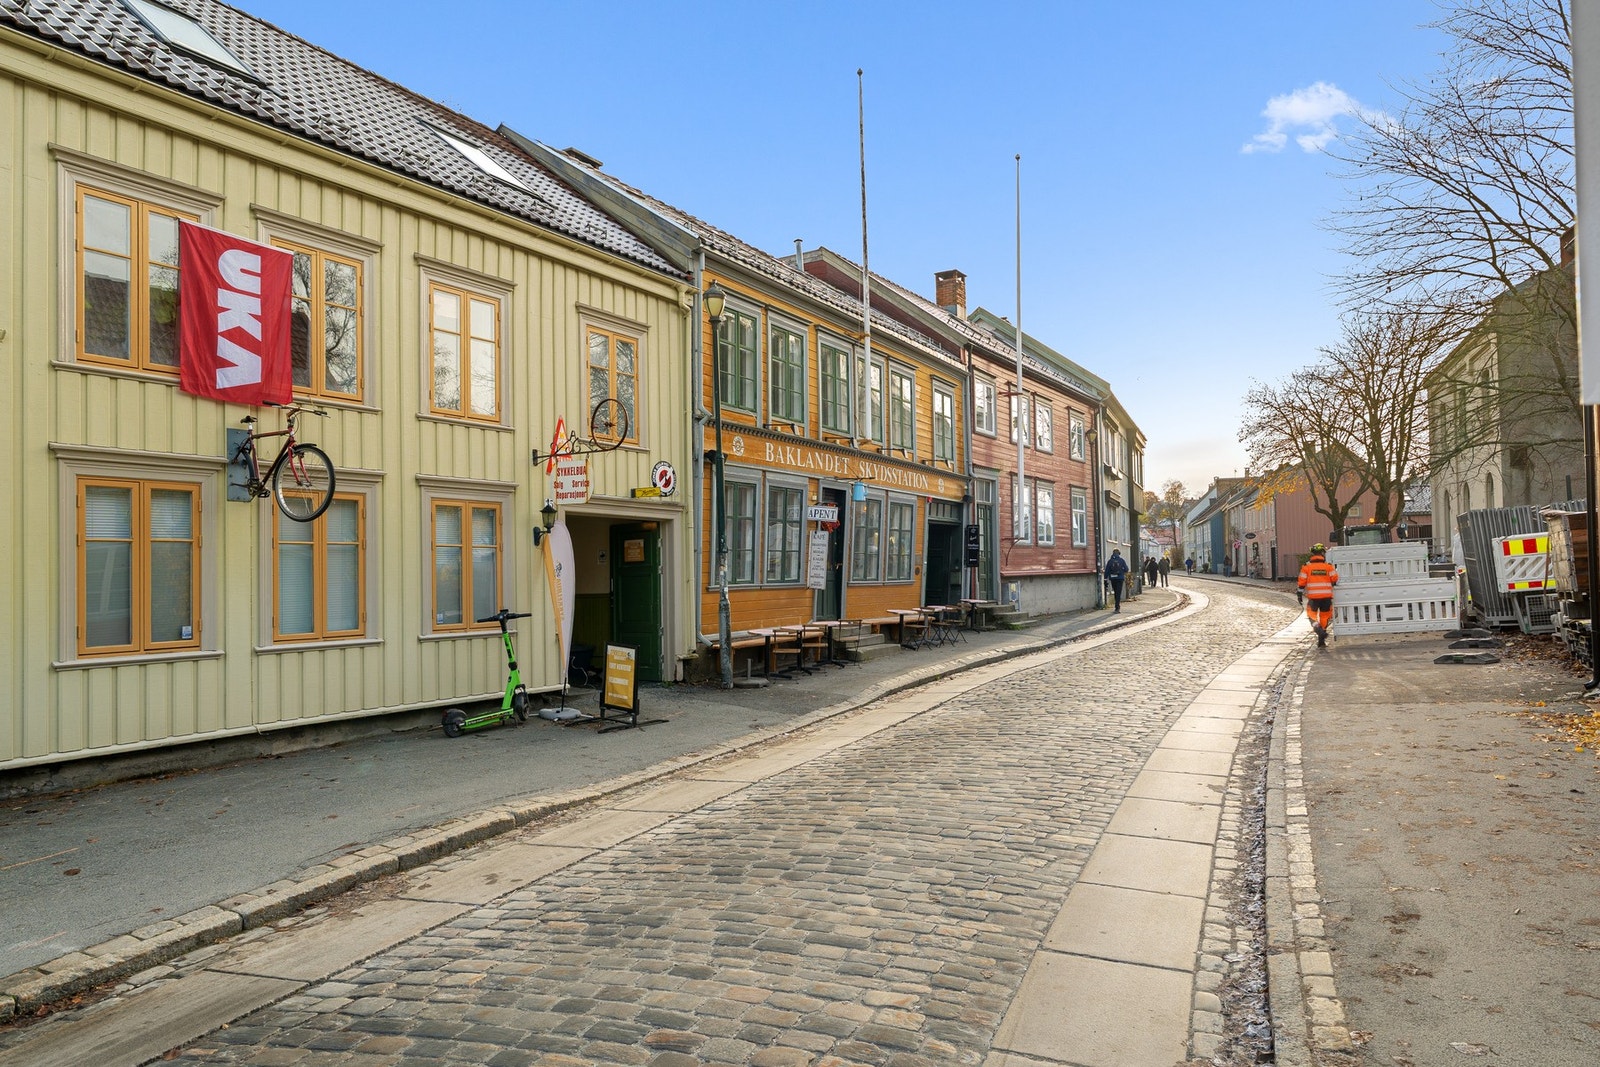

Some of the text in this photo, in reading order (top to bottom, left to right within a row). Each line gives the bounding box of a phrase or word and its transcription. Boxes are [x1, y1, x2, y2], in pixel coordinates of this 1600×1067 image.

[216, 249, 262, 390] UKA
[556, 465, 587, 477] SYKKELBUA
[765, 442, 850, 475] BAKLANDET
[859, 460, 929, 490] SKYDSSTATION
[553, 478, 590, 490] Salg Service
